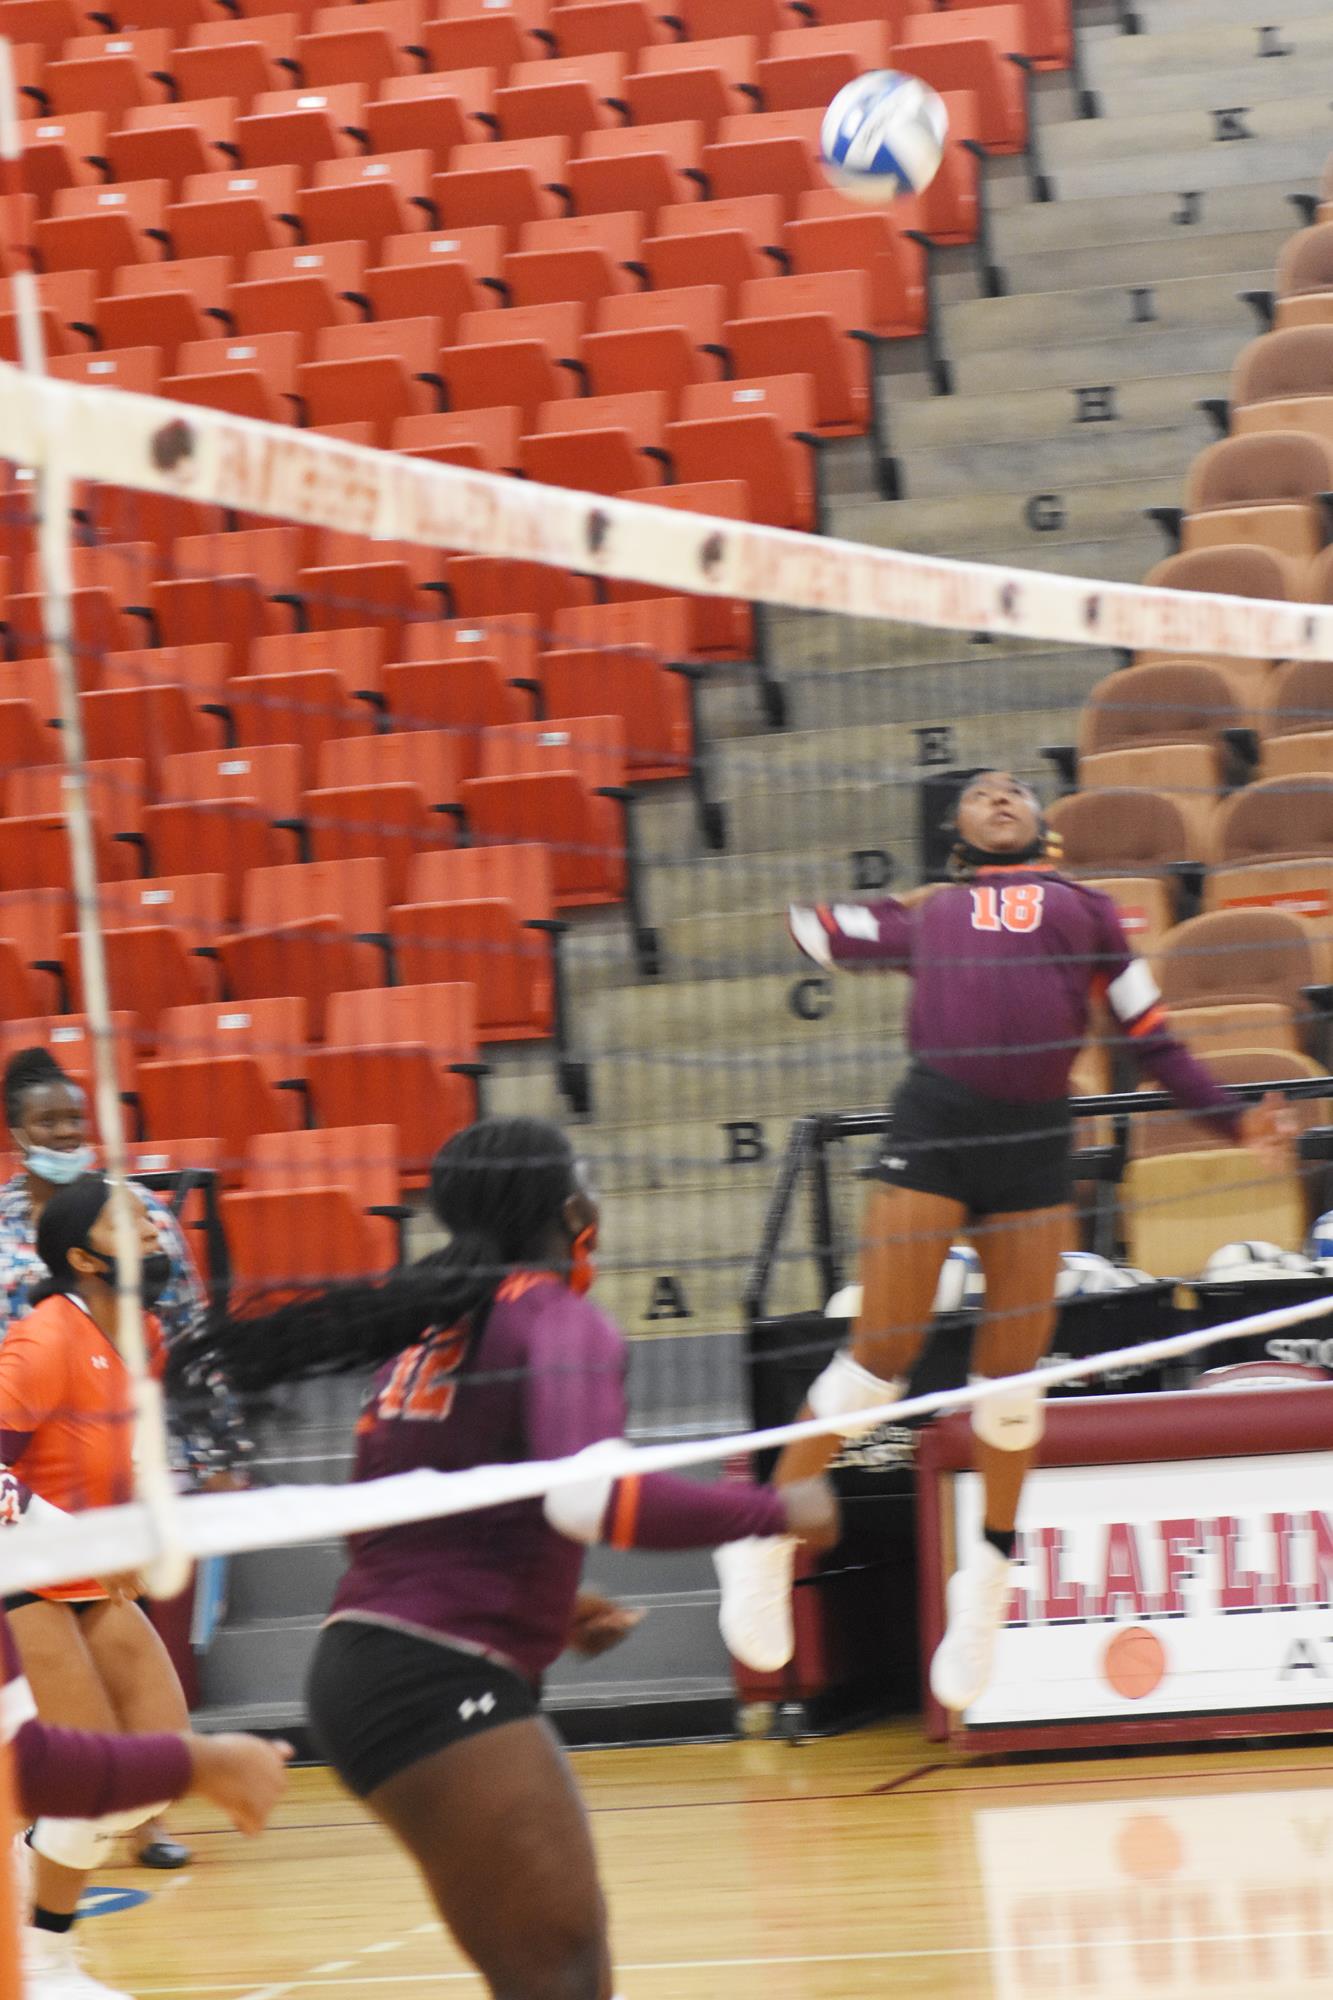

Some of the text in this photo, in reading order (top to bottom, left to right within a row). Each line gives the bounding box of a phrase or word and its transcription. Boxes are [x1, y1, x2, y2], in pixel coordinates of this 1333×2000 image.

[1256, 26, 1291, 57] L
[1074, 386, 1120, 423] H
[1025, 494, 1066, 532] G
[915, 727, 955, 766] E
[853, 850, 894, 890] D
[969, 884, 1044, 933] 18
[789, 979, 833, 1020] C
[725, 1123, 768, 1163] B
[645, 1276, 692, 1320] A
